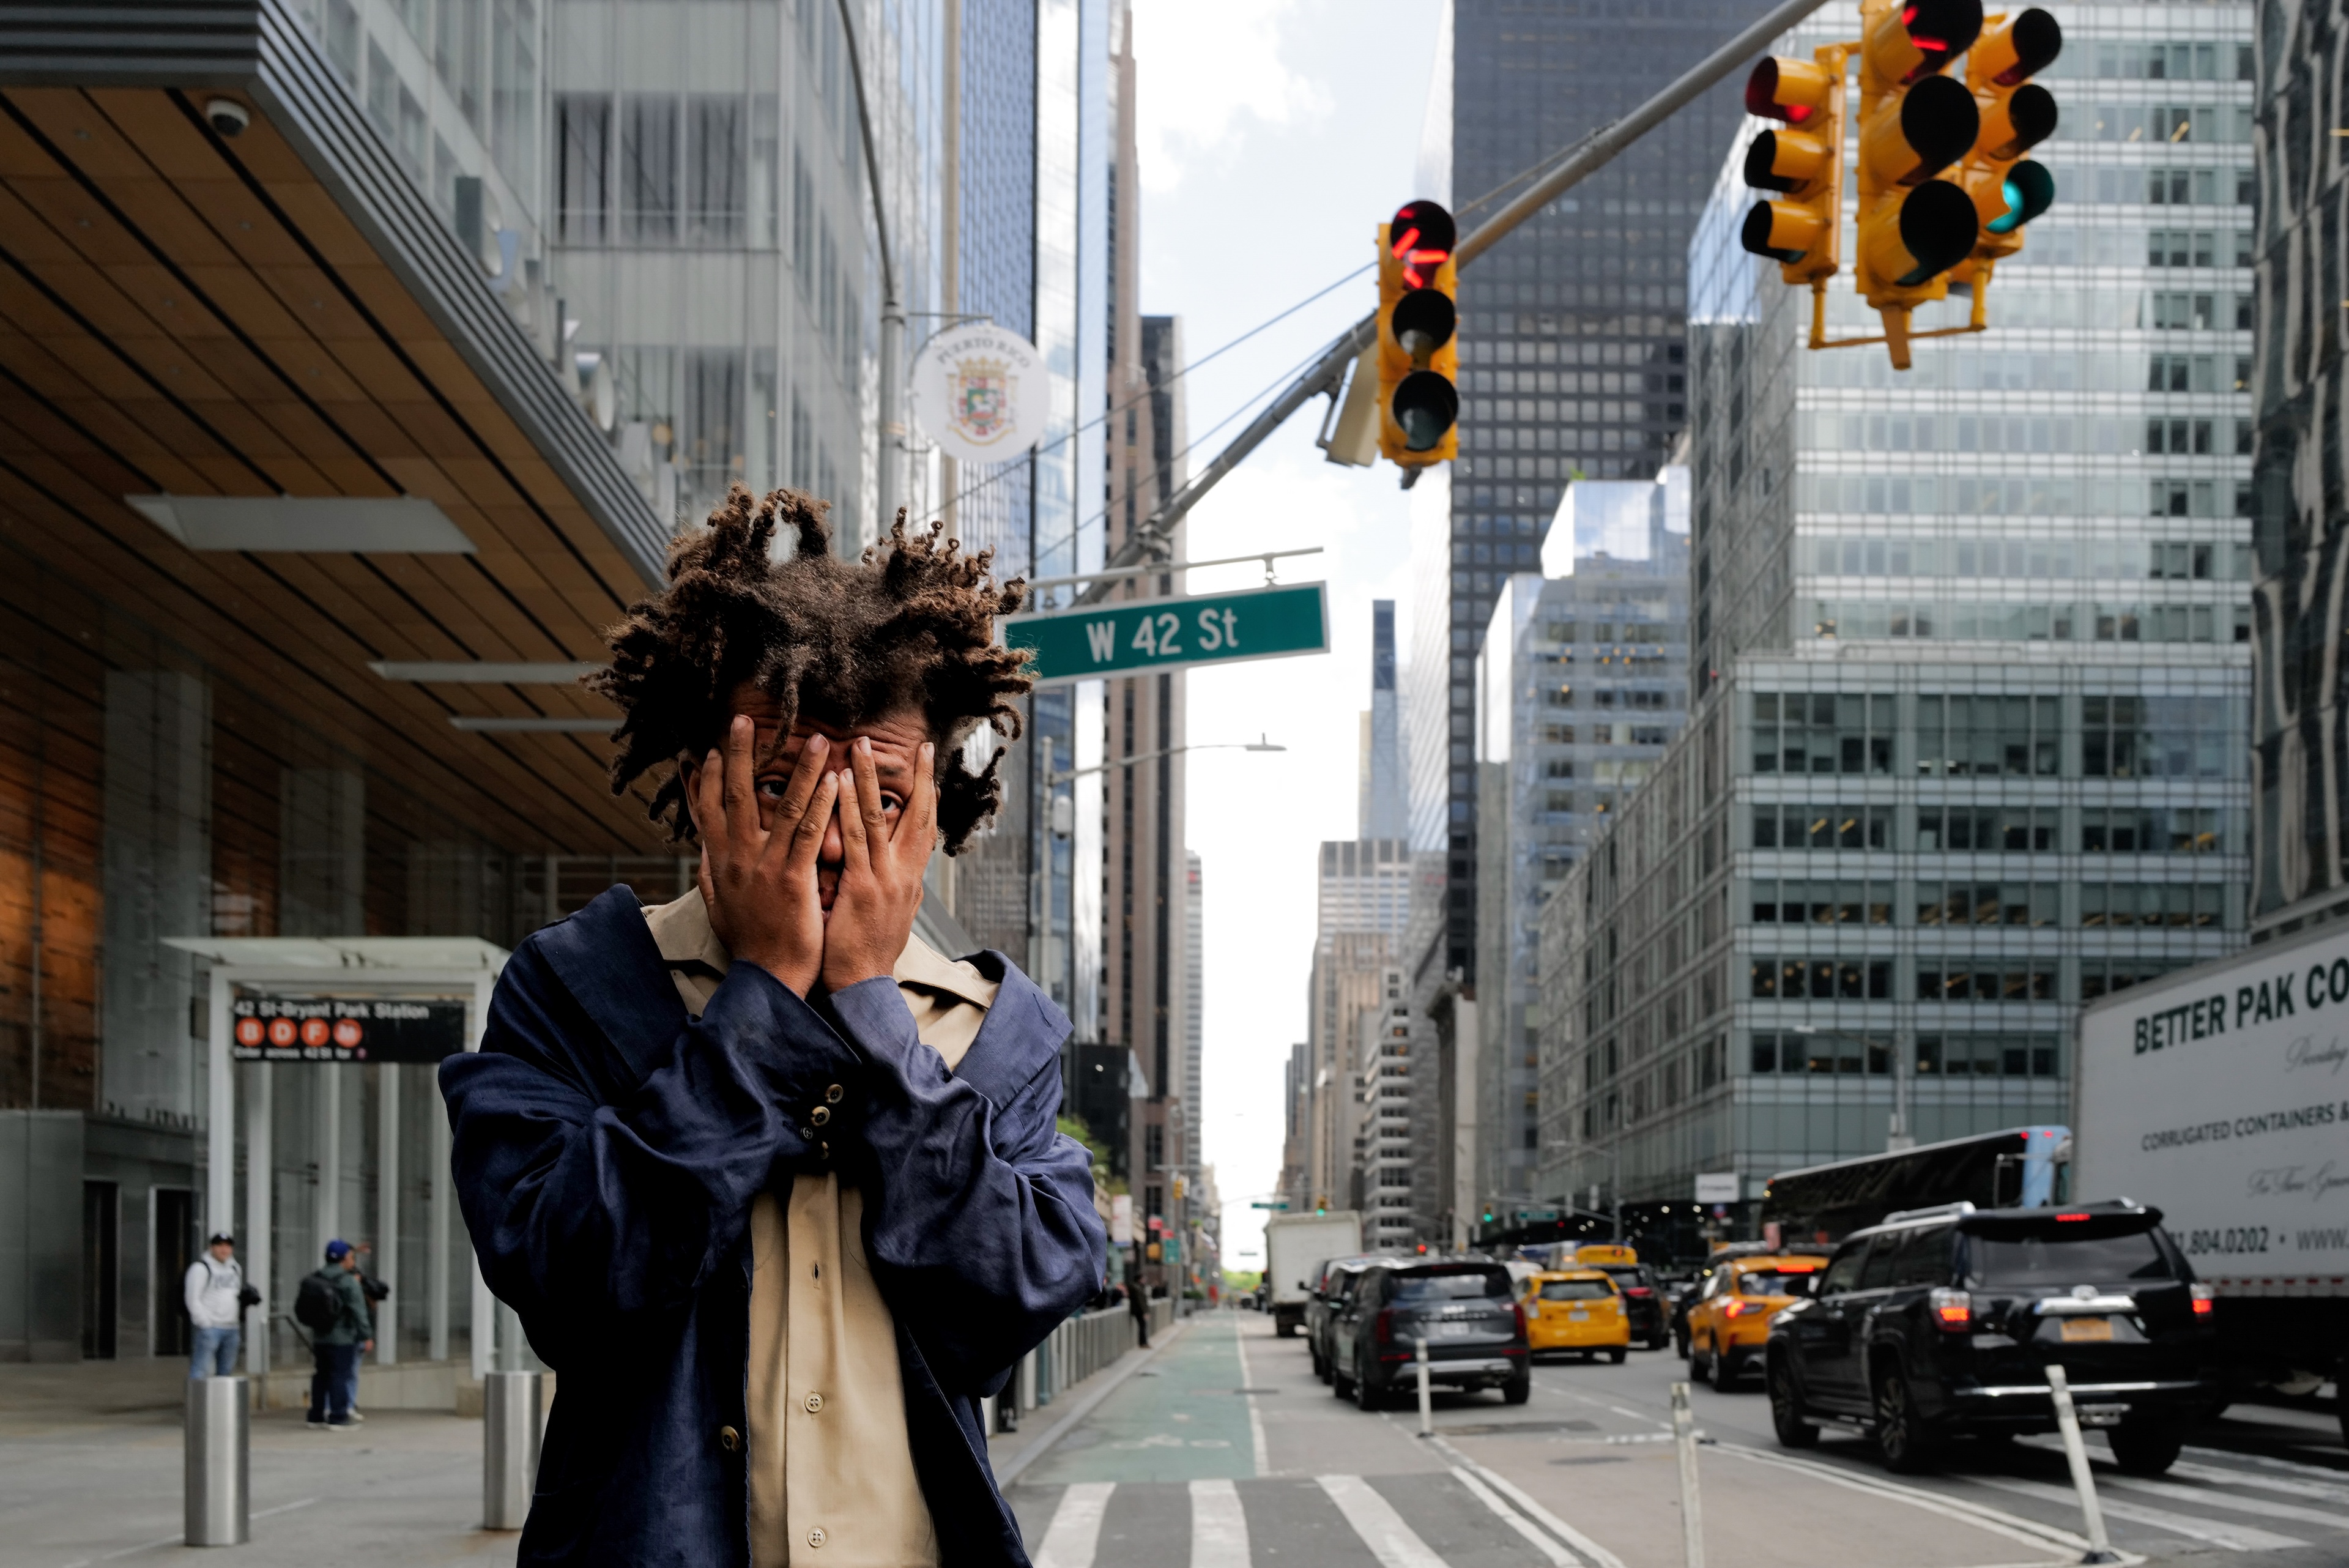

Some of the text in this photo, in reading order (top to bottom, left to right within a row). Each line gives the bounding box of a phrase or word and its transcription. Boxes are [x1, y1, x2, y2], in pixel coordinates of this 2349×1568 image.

[937, 336, 1031, 368] PUERTO RICO
[1086, 608, 1239, 663] W 42 St
[235, 1001, 254, 1017] 42
[335, 1003, 369, 1018] Park
[374, 1003, 429, 1019] Station
[2135, 957, 2349, 1055] BETTER PAK CO
[243, 1023, 258, 1041] B
[276, 1022, 292, 1040] D
[308, 1022, 322, 1041] F
[2142, 1120, 2231, 1151] CORRUGATED
[2235, 1102, 2335, 1139] CONTAINERS
